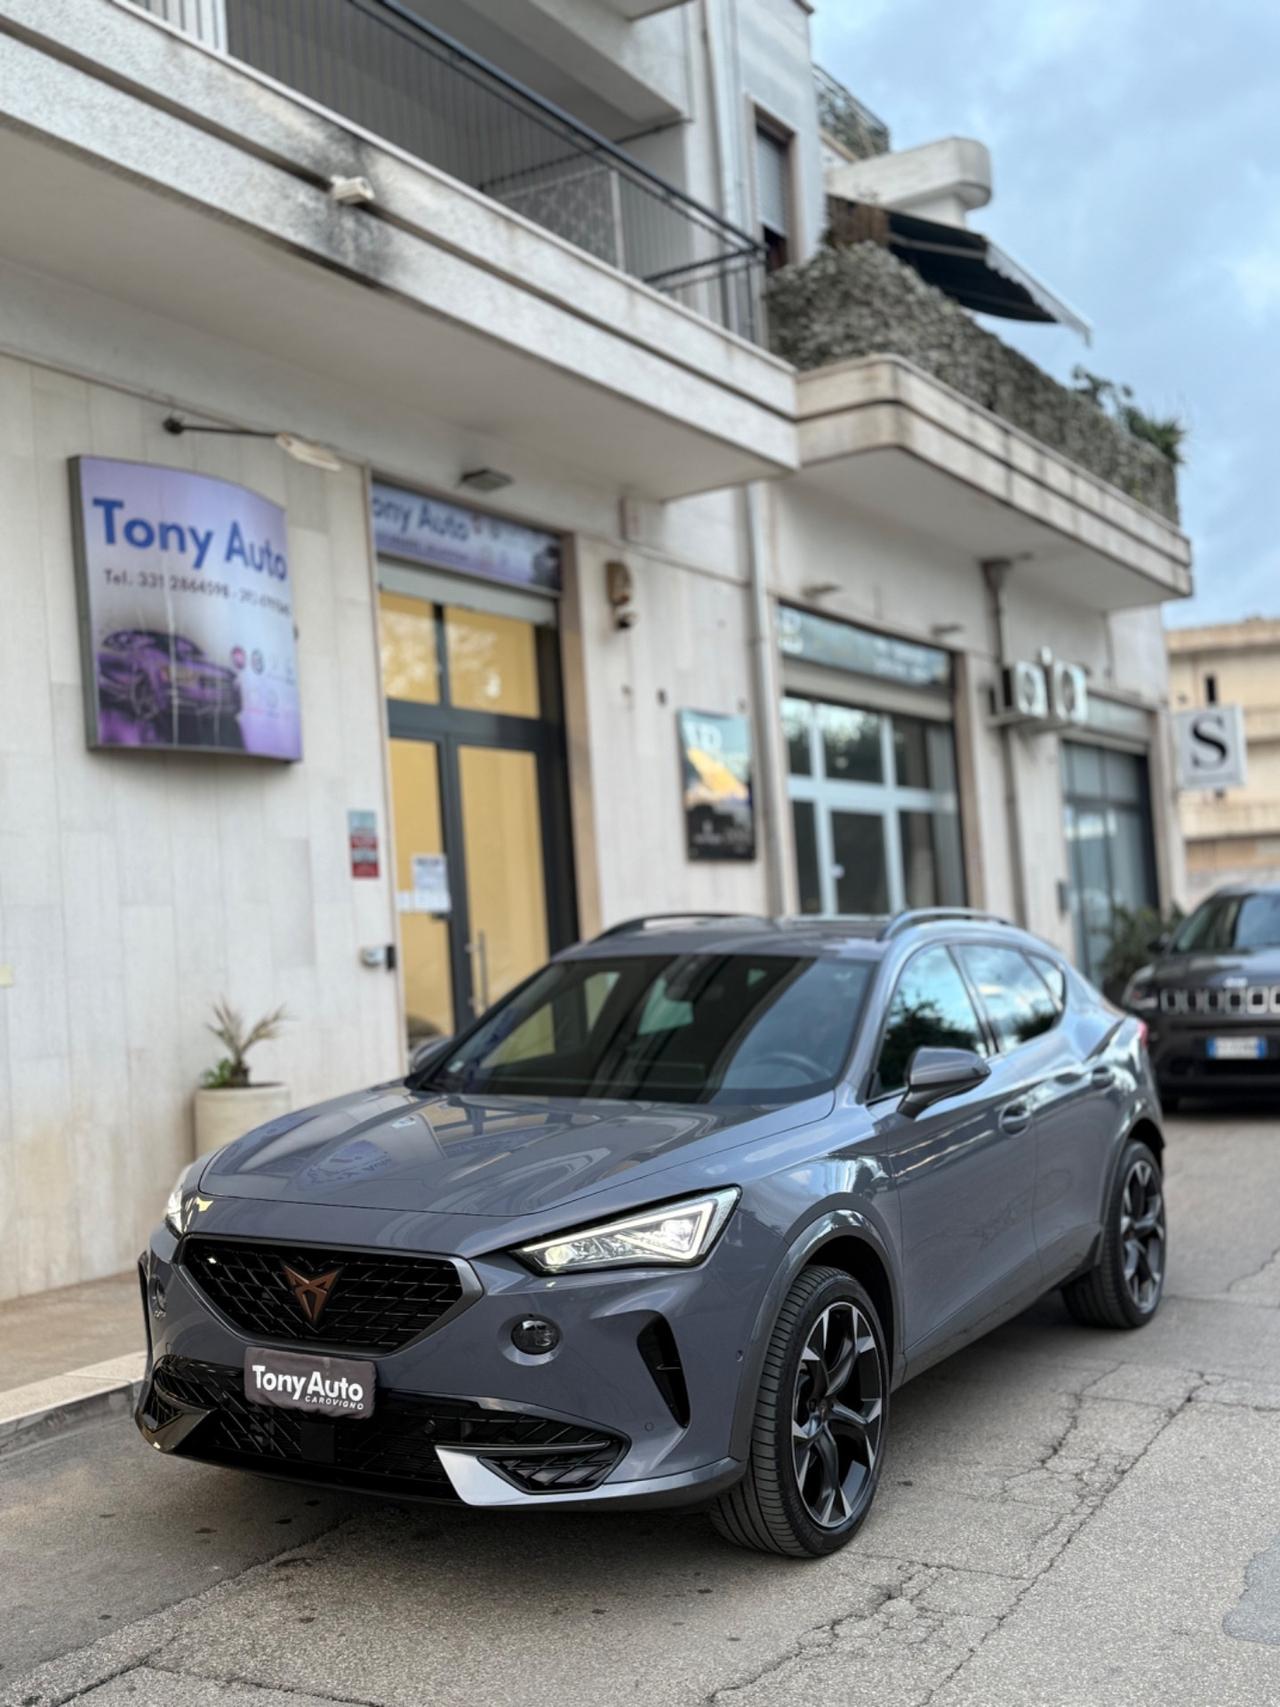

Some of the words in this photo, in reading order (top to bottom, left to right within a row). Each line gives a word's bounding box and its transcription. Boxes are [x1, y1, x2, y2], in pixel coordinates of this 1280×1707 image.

[93, 497, 213, 569] Tony
[225, 521, 287, 581] Auto
[418, 501, 470, 542] Auto
[1190, 713, 1227, 770] S
[252, 1364, 306, 1400] Tony
[307, 1371, 363, 1401] Auto
[305, 1395, 364, 1410] CAROVIGNO
